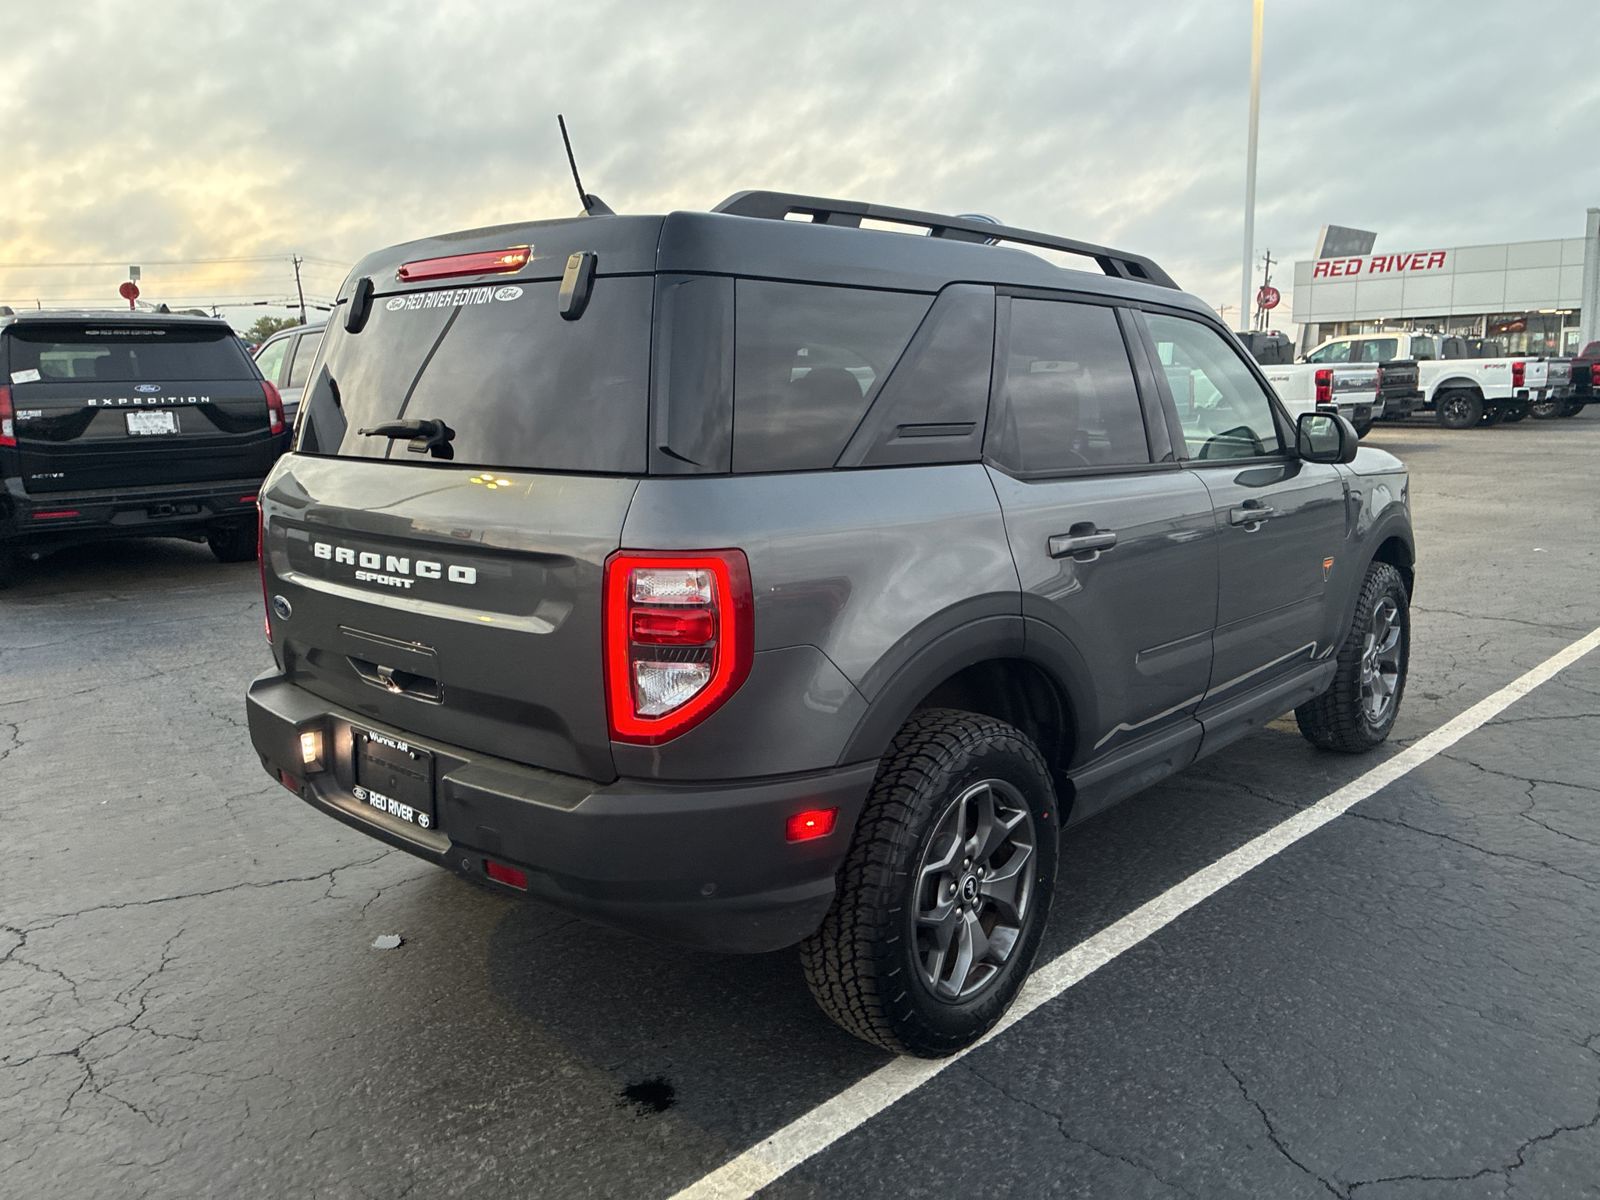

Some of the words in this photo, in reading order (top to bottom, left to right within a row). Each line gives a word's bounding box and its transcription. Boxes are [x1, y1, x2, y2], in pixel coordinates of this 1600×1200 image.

[1313, 258, 1362, 278] RED
[1369, 251, 1446, 274] RIVER
[404, 293, 425, 310] RED
[423, 289, 453, 309] RIVER
[452, 286, 497, 306] EDITION
[88, 396, 210, 406] EXPEDITION
[314, 542, 477, 585] BRONCO
[355, 570, 414, 588] SPORT
[397, 741, 408, 752] AR
[369, 791, 387, 811] RED
[388, 798, 413, 823] RIVER
